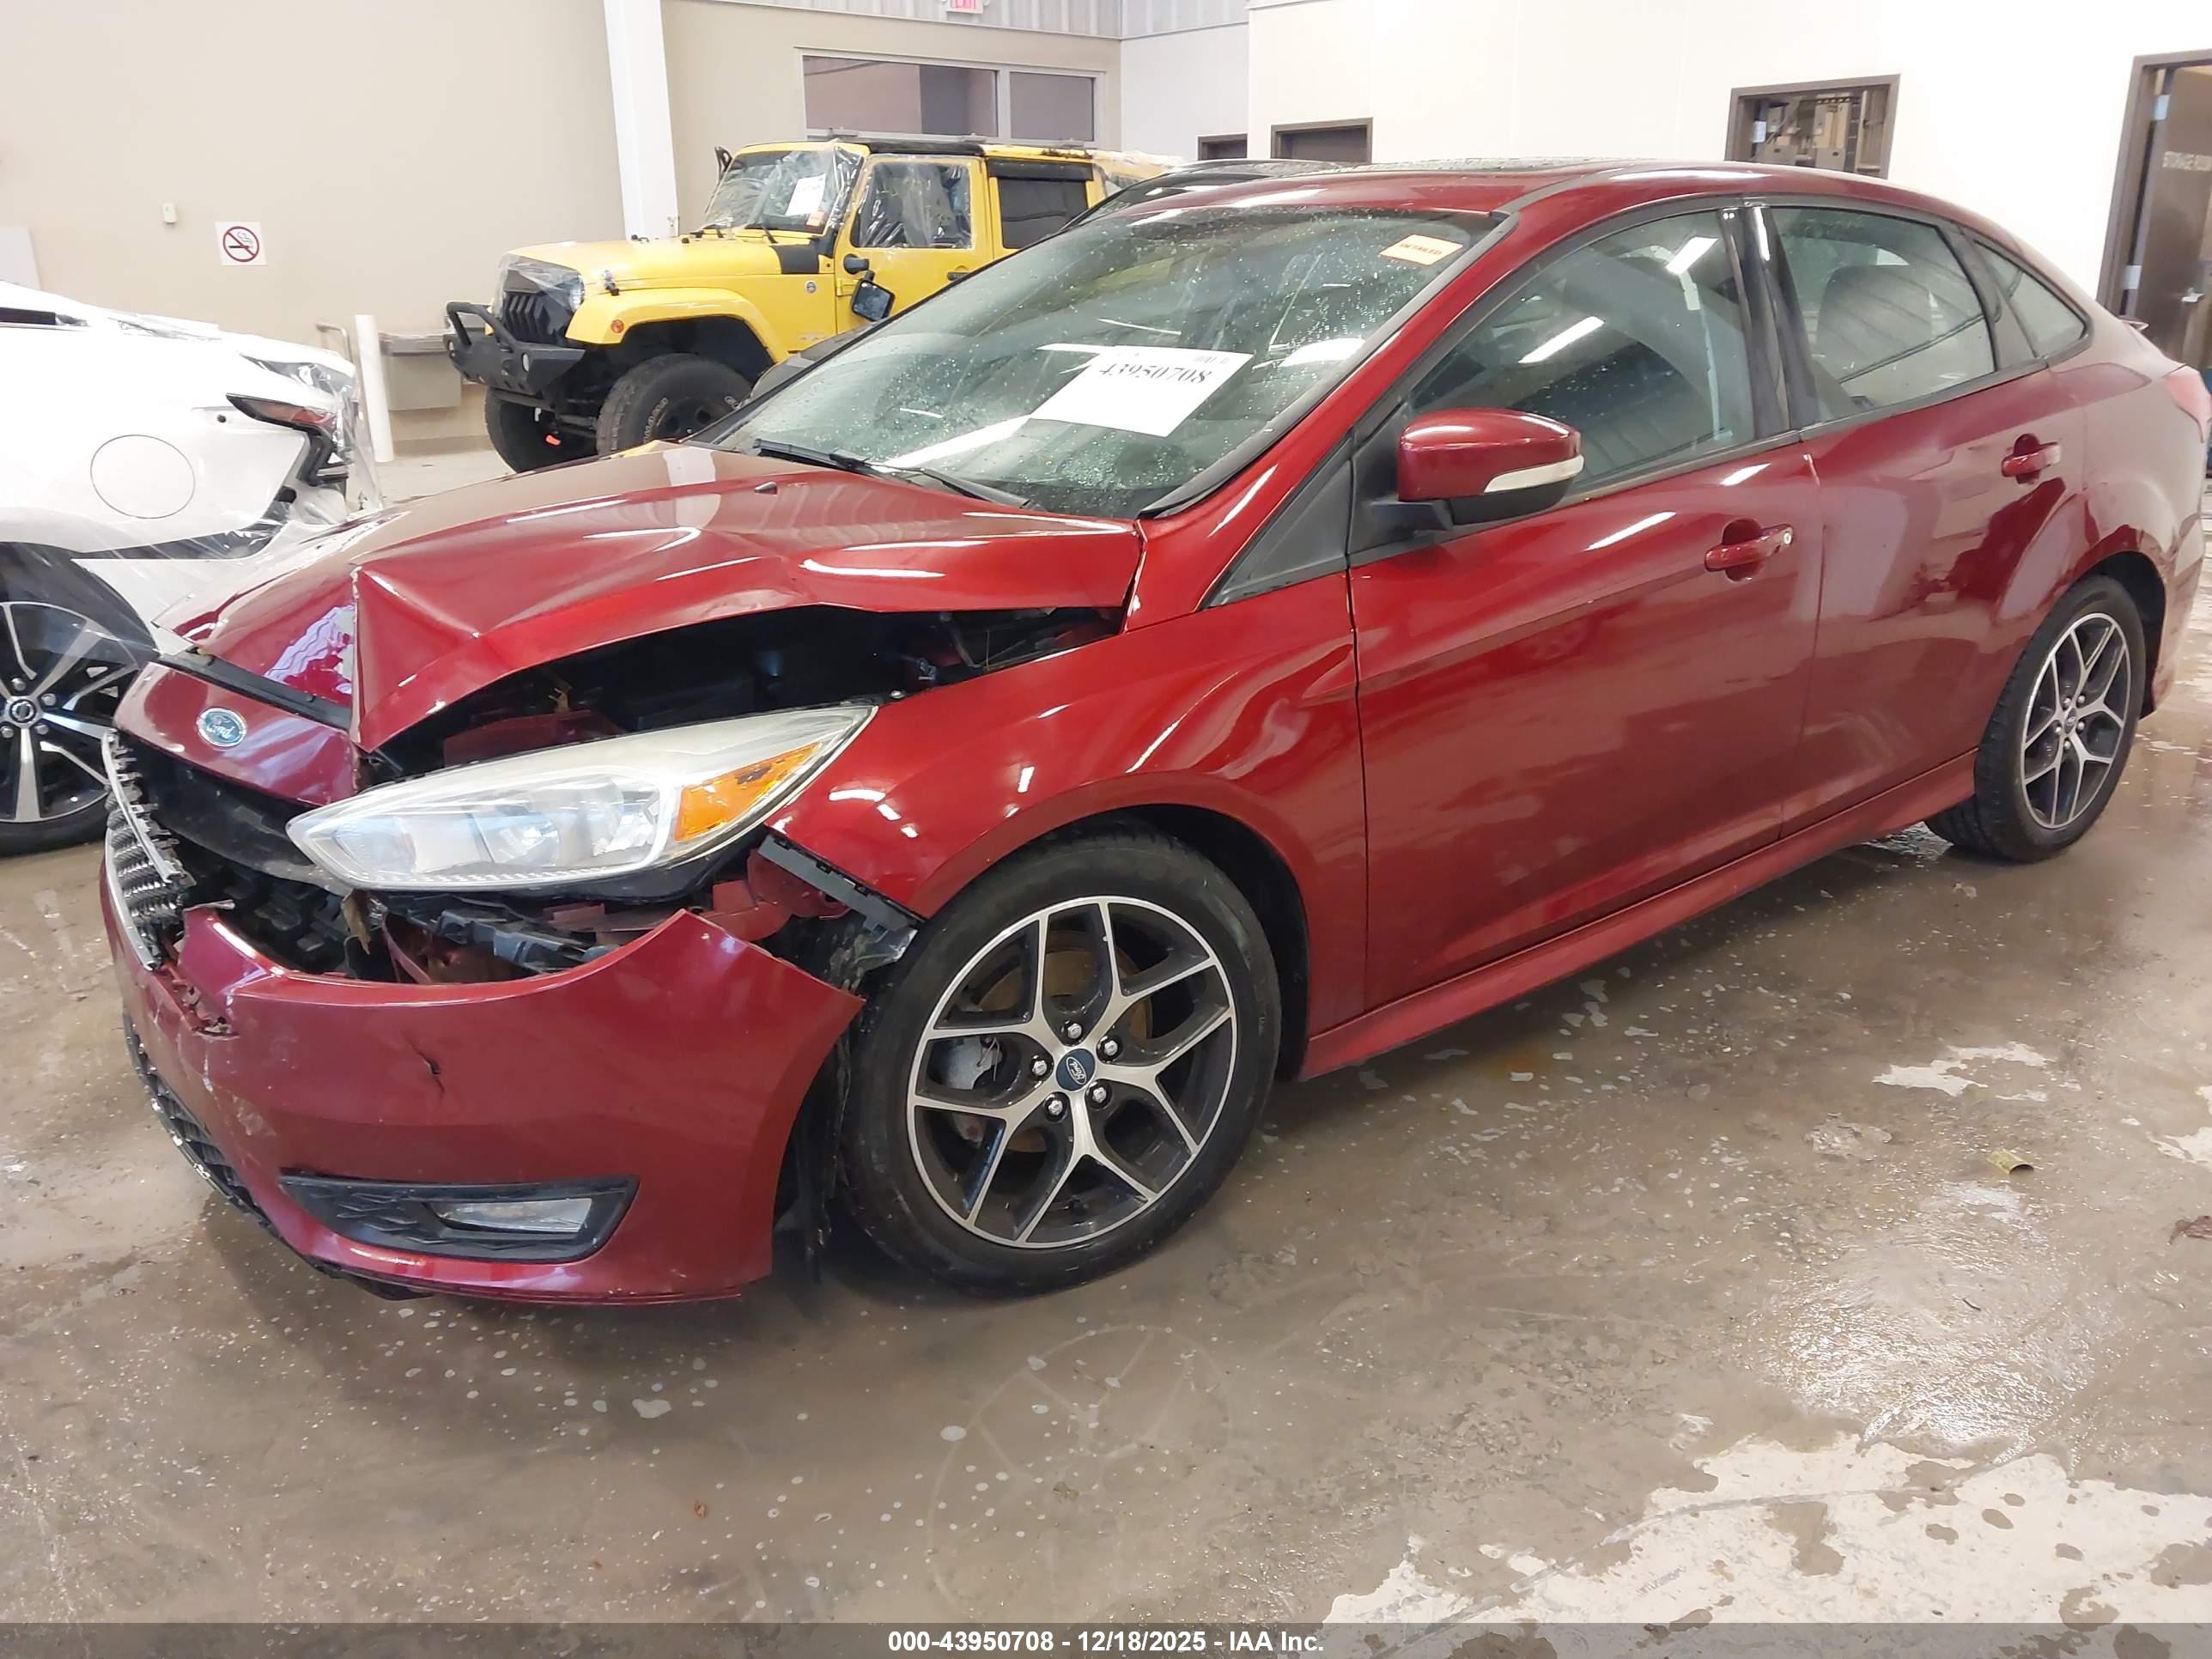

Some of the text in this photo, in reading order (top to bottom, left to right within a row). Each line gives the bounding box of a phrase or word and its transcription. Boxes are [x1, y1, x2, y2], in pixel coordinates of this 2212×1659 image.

[1398, 242, 1443, 256] DETAILED
[1098, 362, 1213, 383] 43950708
[205, 714, 236, 739] Ford
[1069, 1060, 1086, 1080] Ford
